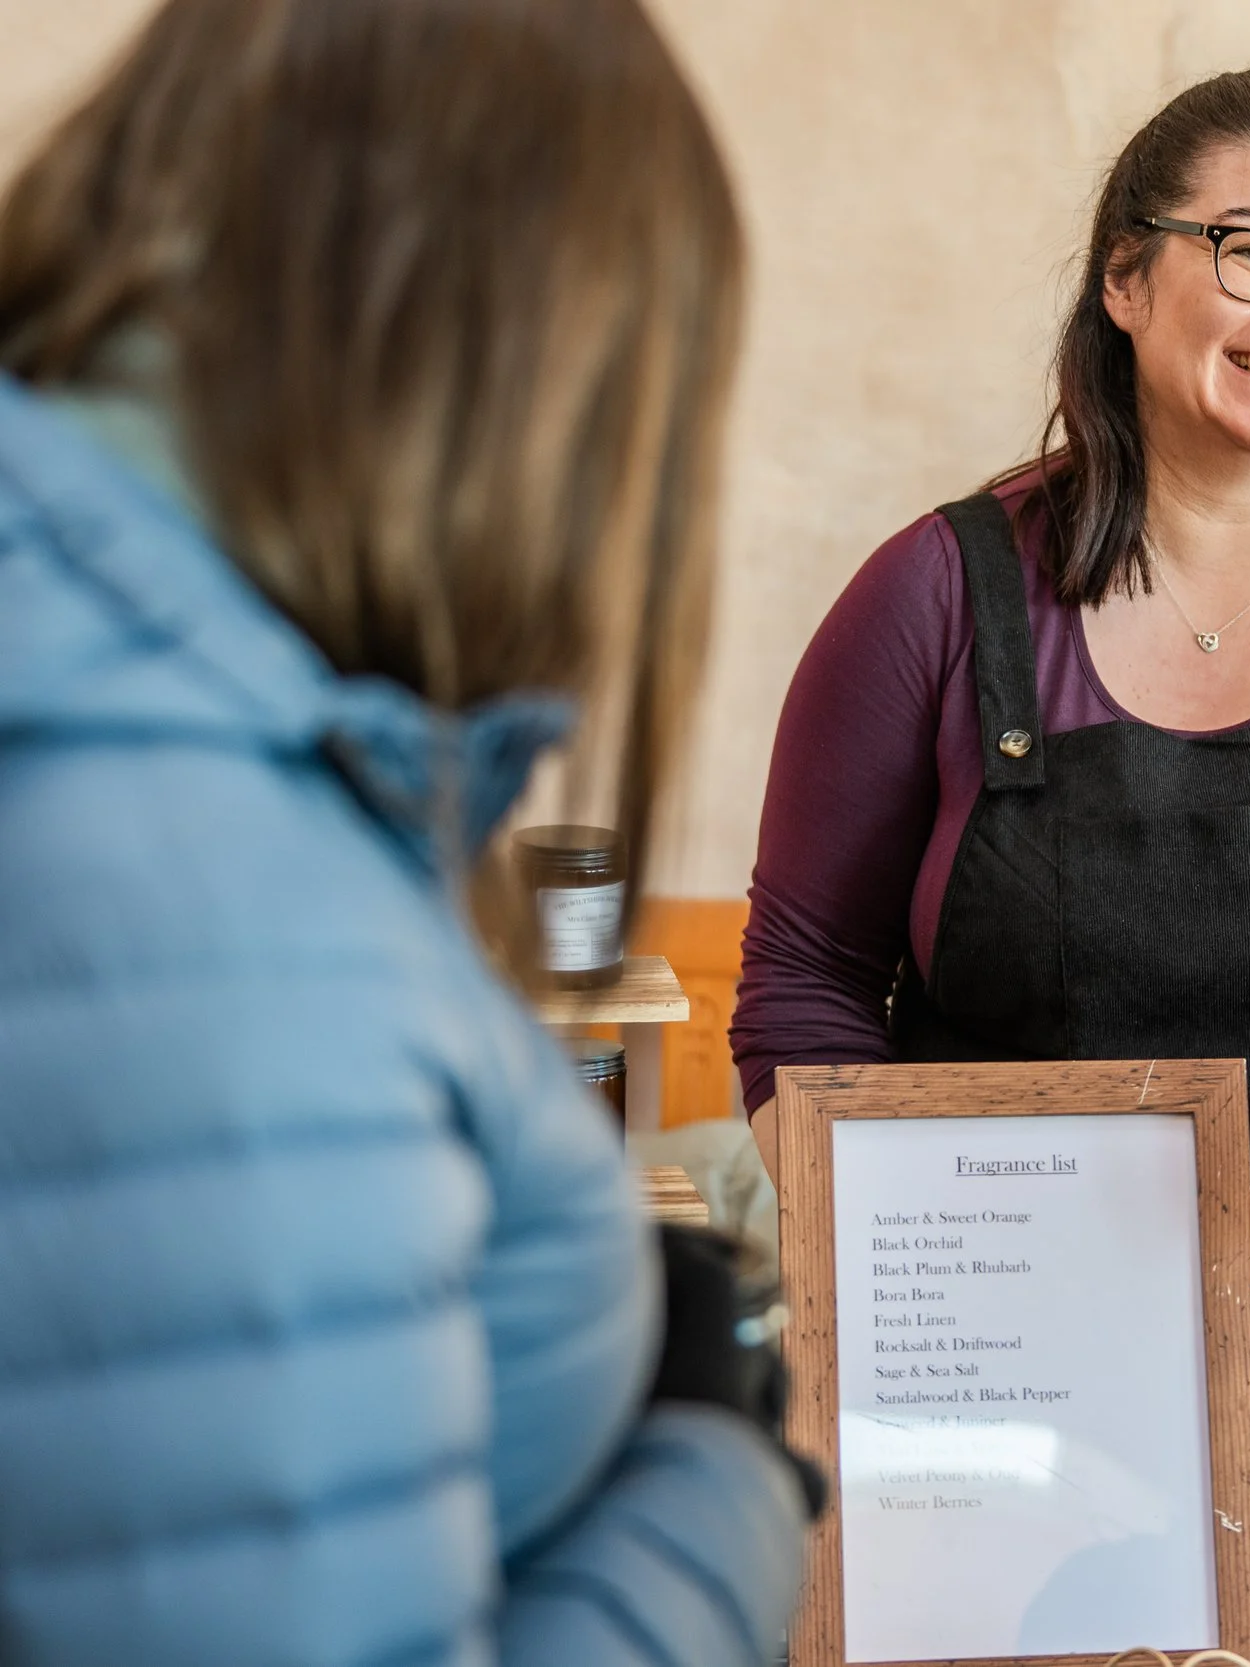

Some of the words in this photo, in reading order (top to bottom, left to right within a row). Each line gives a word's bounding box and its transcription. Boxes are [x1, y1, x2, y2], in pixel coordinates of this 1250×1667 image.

[957, 1156, 1046, 1175] Fragrance
[1053, 1154, 1077, 1171] list
[872, 1212, 919, 1225] Amber
[923, 1212, 933, 1224] &
[939, 1212, 977, 1223] Sweet
[982, 1211, 1031, 1224] Orange
[873, 1238, 910, 1251] Black
[915, 1236, 962, 1249] Orchid
[874, 1263, 911, 1276] Black
[917, 1262, 951, 1275] Plum
[955, 1262, 966, 1274] &
[972, 1260, 1031, 1274] Rhubarb
[874, 1289, 906, 1301] Bora
[912, 1288, 944, 1300] Bora
[875, 1314, 911, 1327] Fresh
[917, 1313, 956, 1326] Linen
[876, 1339, 931, 1352] Rocksalt
[936, 1339, 947, 1351] &
[953, 1336, 1021, 1350] Driftwood
[876, 1367, 905, 1380] Sage
[910, 1365, 921, 1377] &
[927, 1365, 950, 1377] Sea
[955, 1363, 978, 1376] Salt
[876, 1389, 959, 1404] Sandalwood
[963, 1389, 974, 1402] &
[980, 1388, 1017, 1401] Black
[1023, 1388, 1070, 1403] Pepper
[879, 1471, 921, 1484] Velvet
[925, 1469, 966, 1485] Peony
[878, 1496, 927, 1510] Winter
[934, 1496, 982, 1508] Berries
